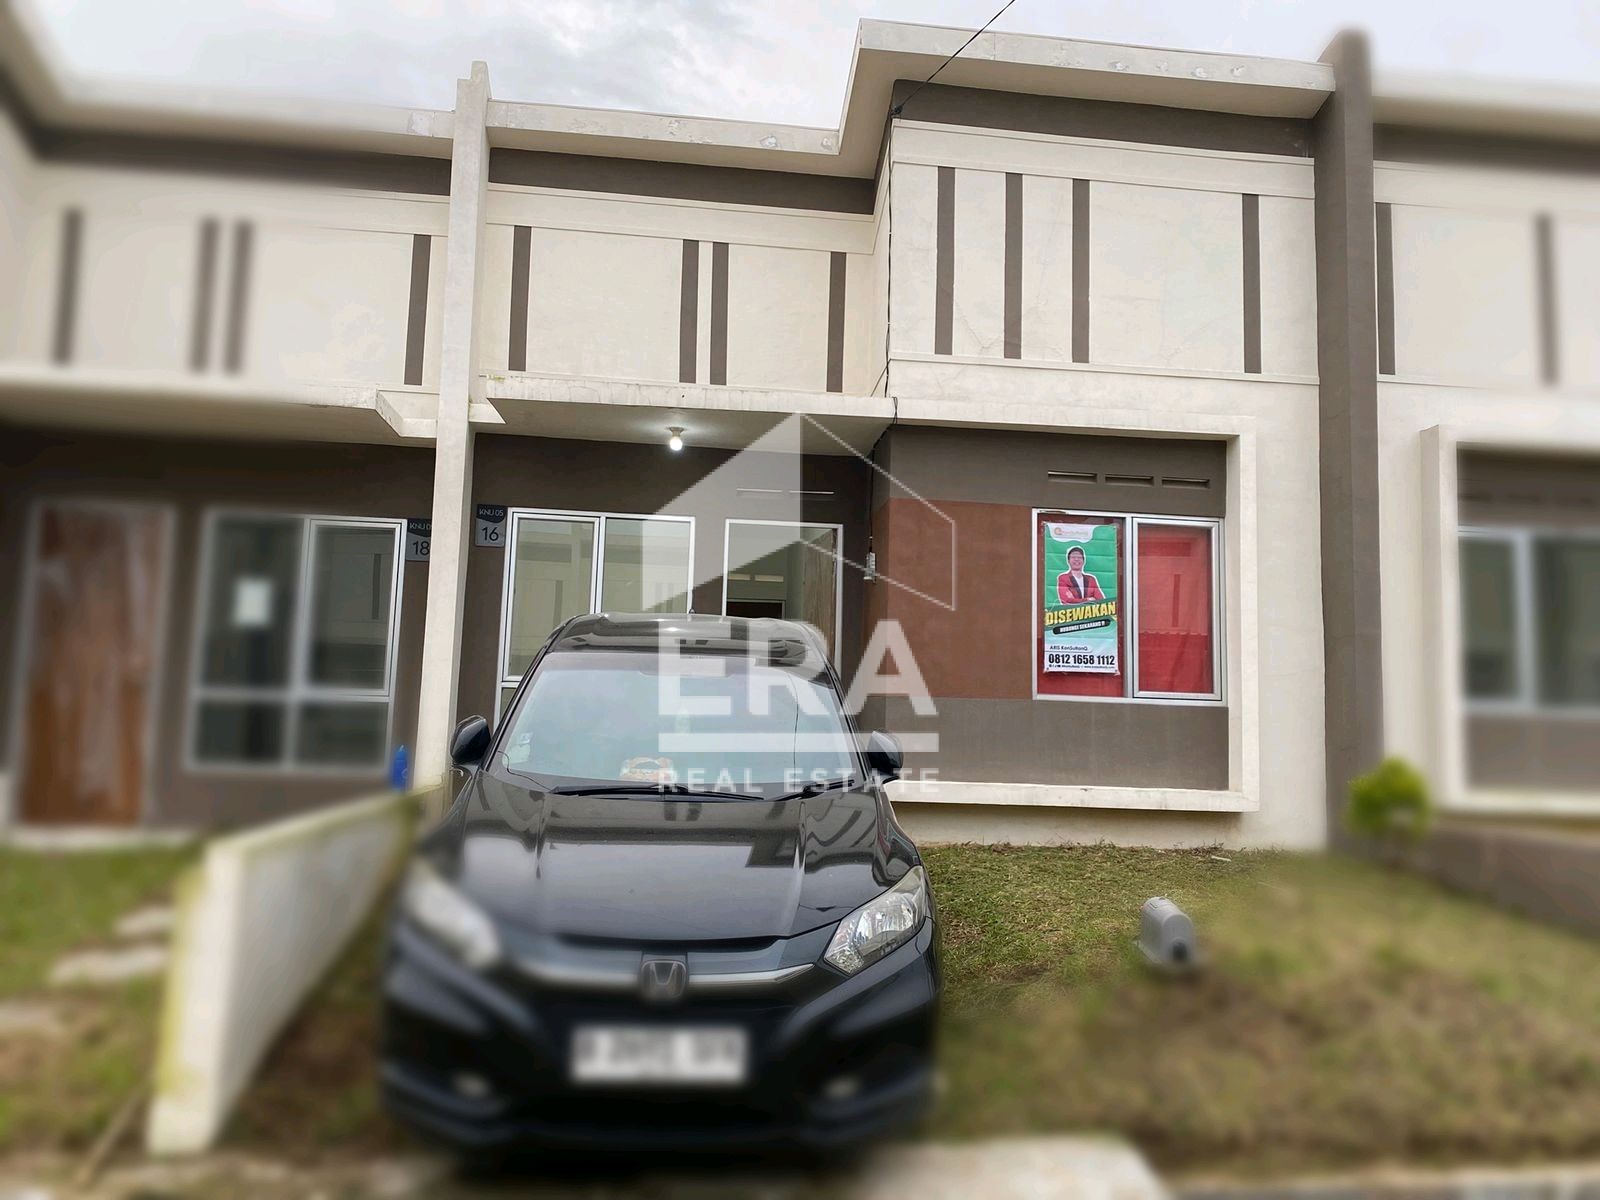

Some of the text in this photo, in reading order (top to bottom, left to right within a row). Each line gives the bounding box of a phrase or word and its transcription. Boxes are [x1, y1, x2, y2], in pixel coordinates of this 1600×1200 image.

[479, 508, 504, 517] KNU 05
[482, 526, 499, 541] 16
[413, 541, 430, 556] 18
[1045, 602, 1116, 626] DISEWAKAN
[1048, 653, 1115, 665] 0812 1658 1112
